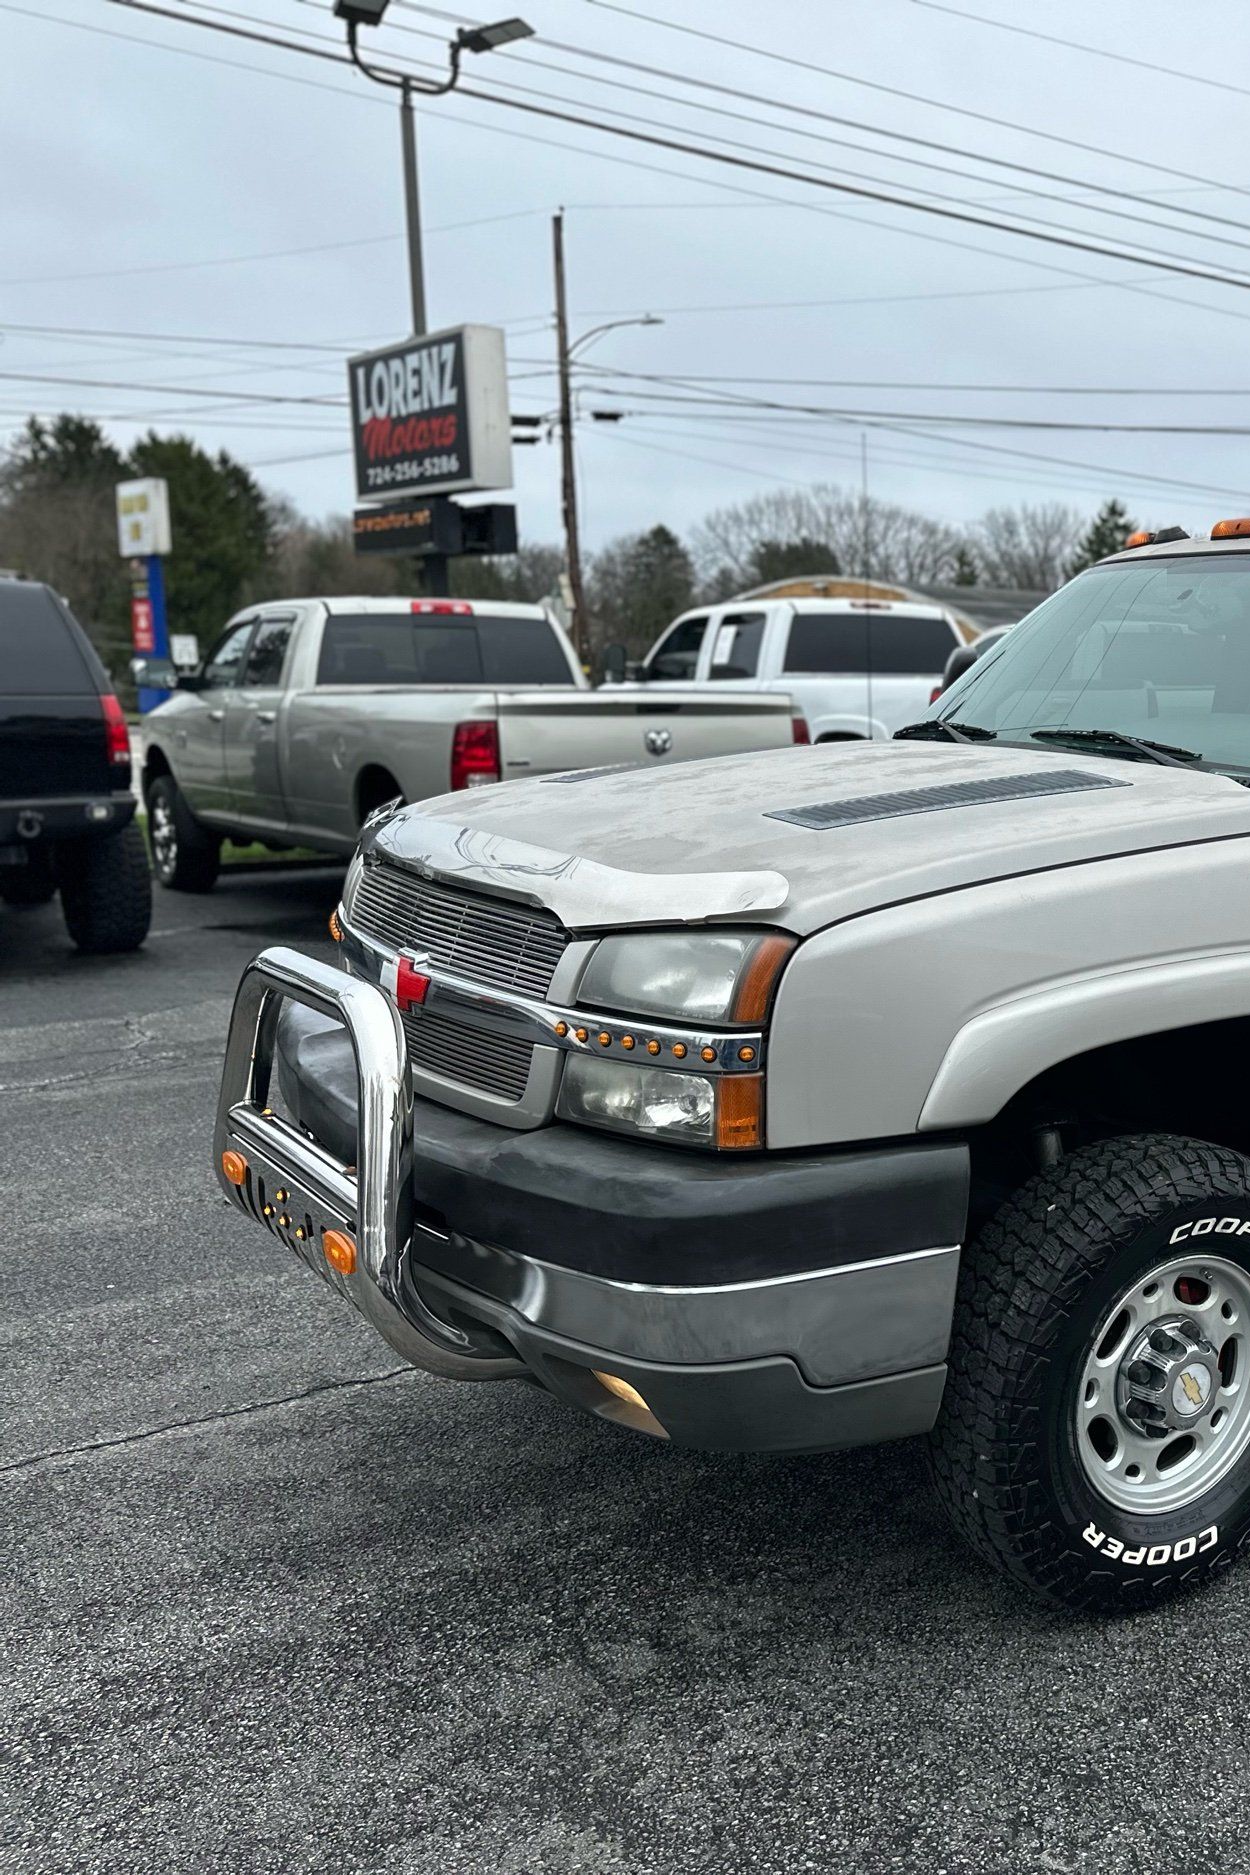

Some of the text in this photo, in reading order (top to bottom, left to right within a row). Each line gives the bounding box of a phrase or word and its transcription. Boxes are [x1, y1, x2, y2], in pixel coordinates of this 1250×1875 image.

[356, 342, 459, 425] LORENZ
[363, 413, 457, 462] Motors
[366, 453, 460, 486] 724-256-5286
[1082, 1521, 1218, 1566] COOPER
